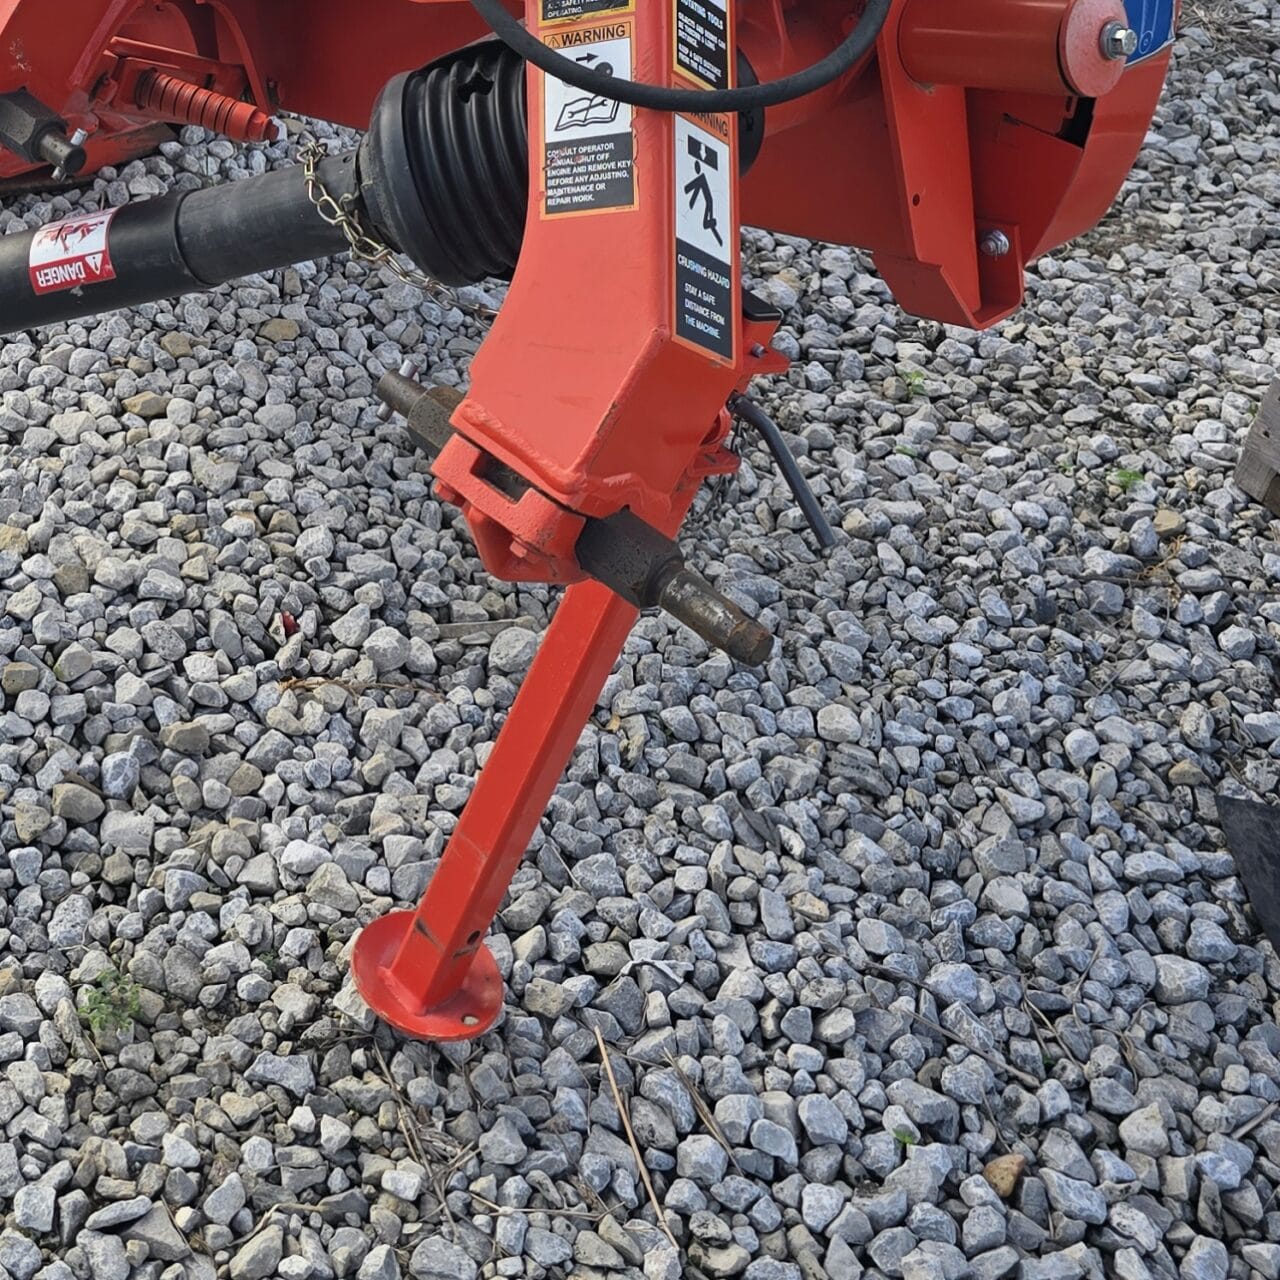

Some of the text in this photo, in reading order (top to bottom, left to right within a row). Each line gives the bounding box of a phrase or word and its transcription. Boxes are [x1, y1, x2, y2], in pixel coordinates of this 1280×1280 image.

[707, 12, 723, 30] TOOLS
[561, 24, 625, 46] WARNING
[690, 112, 728, 137] ARNING
[578, 143, 614, 154] OPERATOR
[596, 153, 609, 161] OFF
[547, 160, 631, 177] ENGINE AND REMOVE KEY
[547, 176, 573, 186] BEFORE
[575, 175, 589, 183] ANY
[547, 183, 606, 197] MAINTENANCE OR
[547, 197, 571, 205] REPAIR
[36, 261, 86, 287] DANGER
[678, 254, 730, 289] CRUSHING HAZARD
[685, 283, 697, 296] STAY
[702, 292, 715, 305] SAFE
[685, 299, 725, 325] DISTANCE FROM
[685, 314, 695, 327] THE
